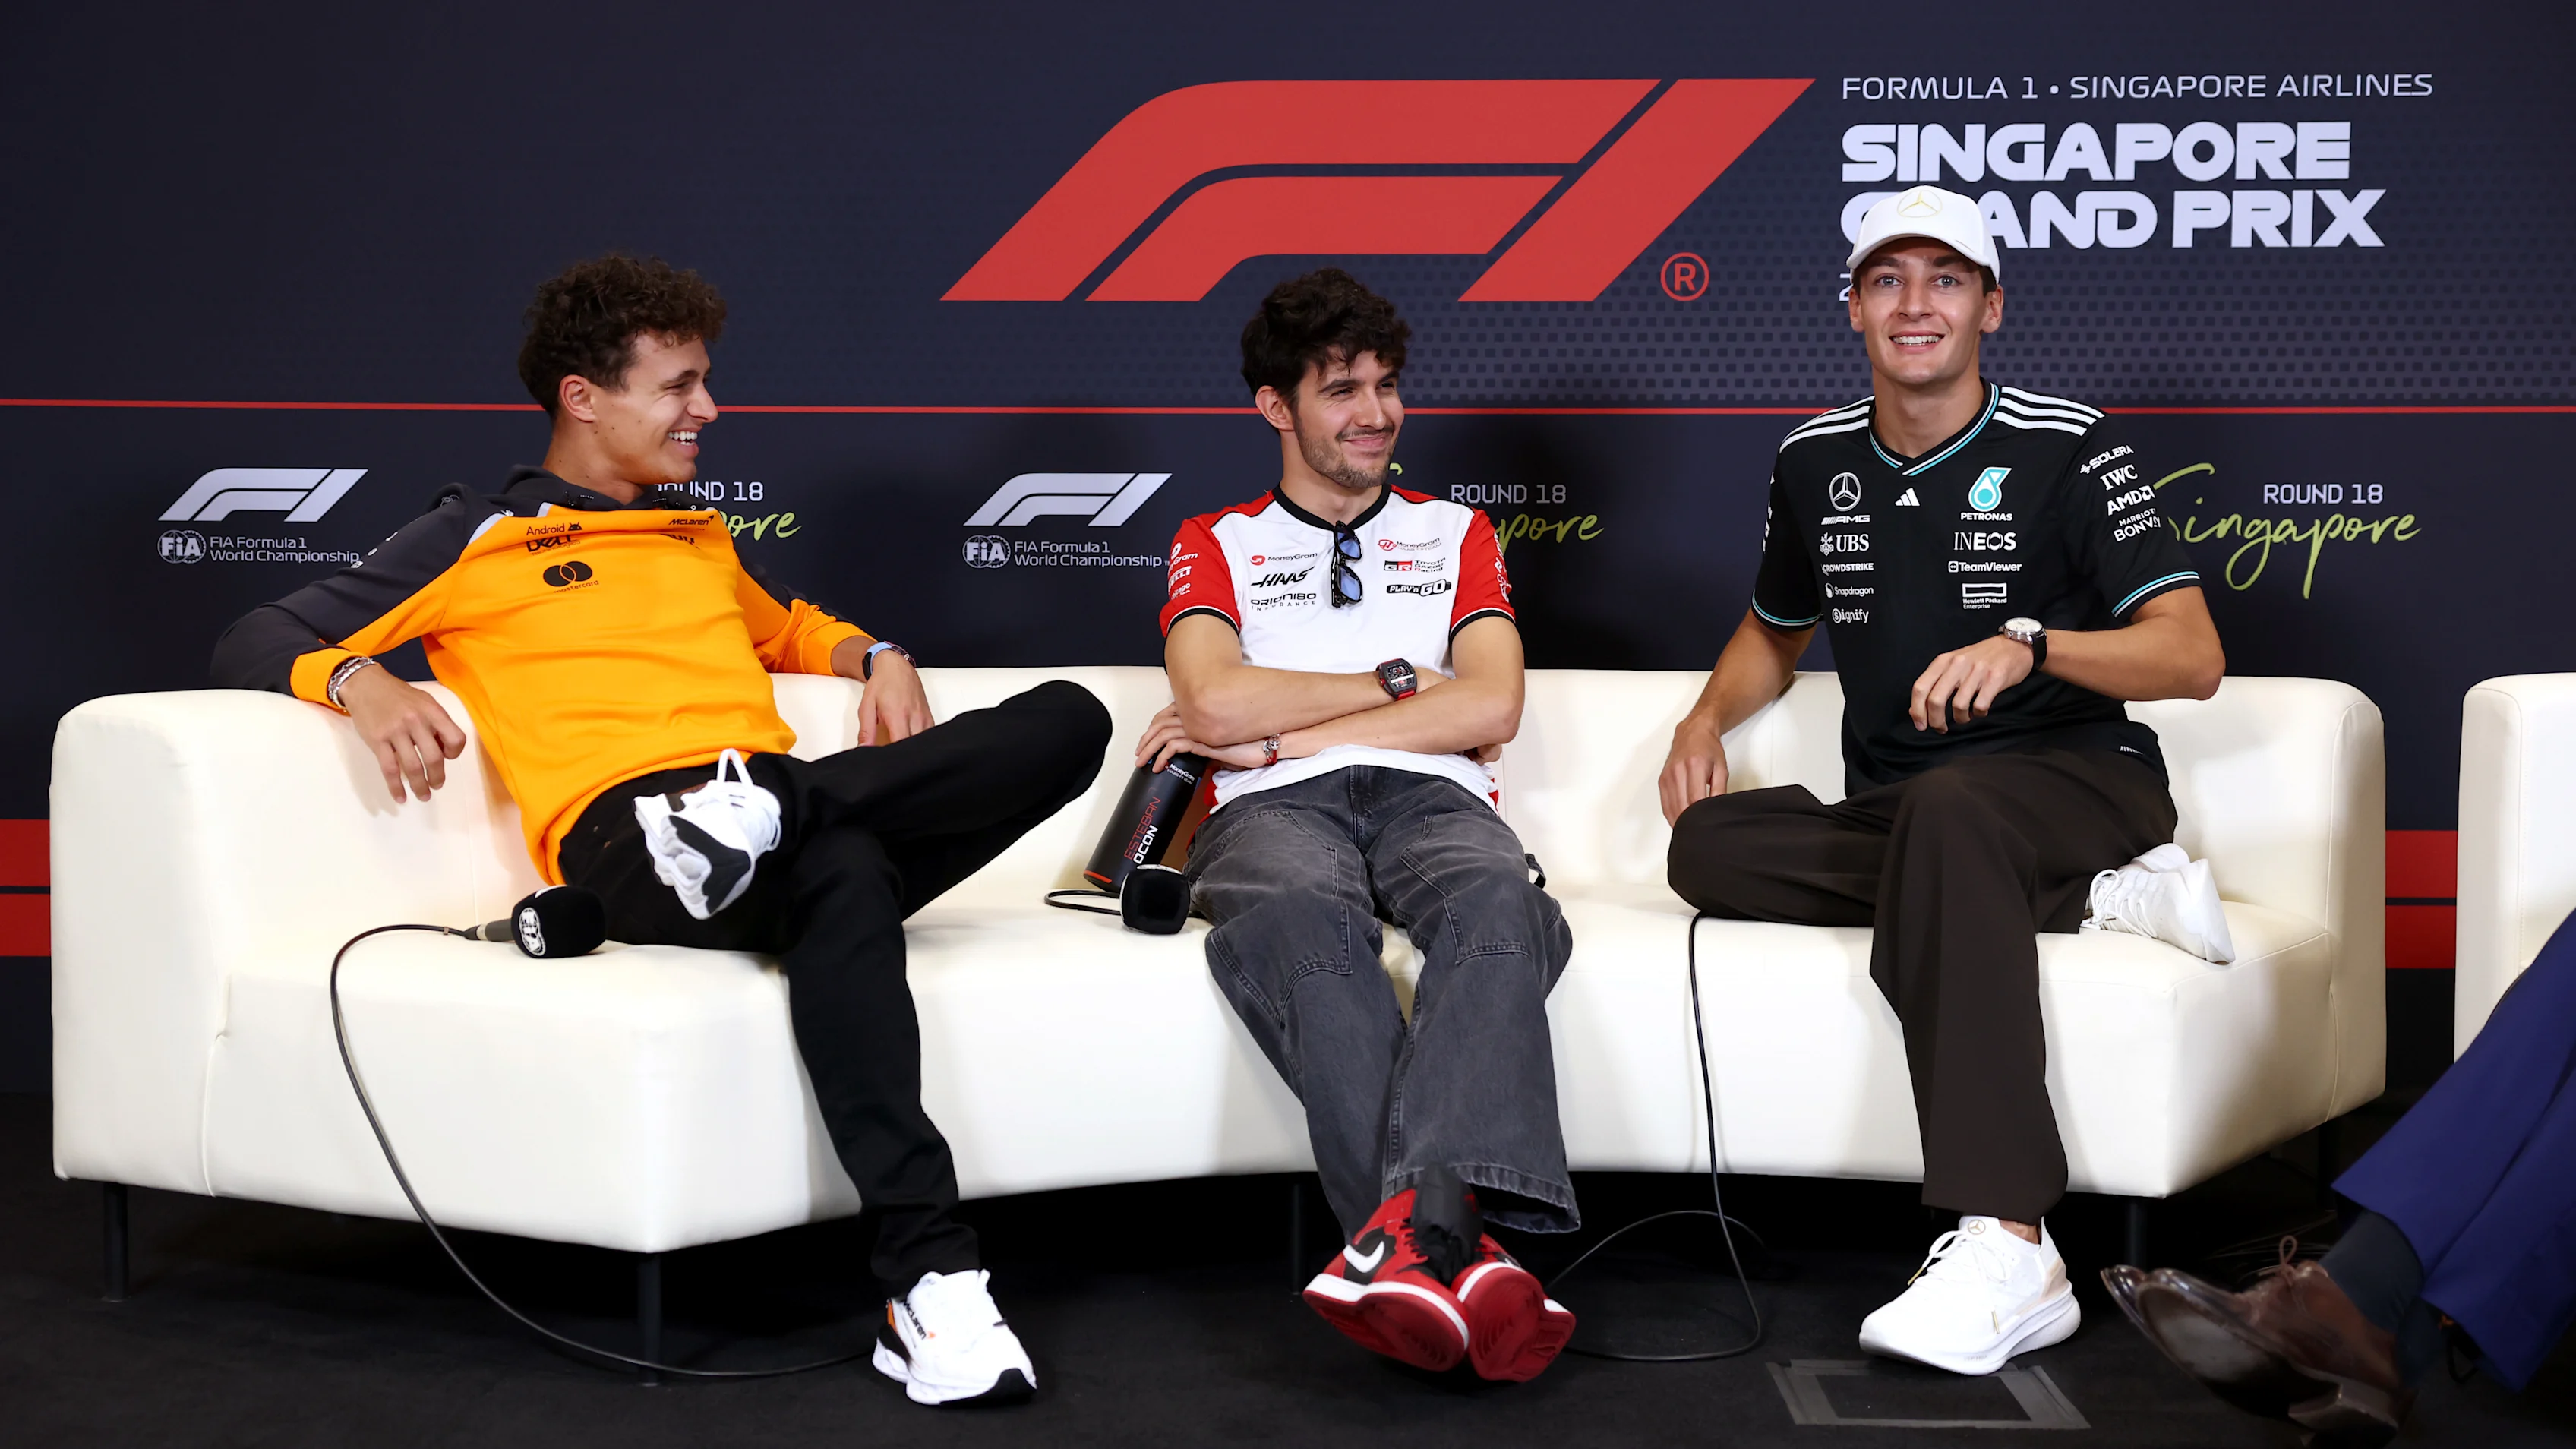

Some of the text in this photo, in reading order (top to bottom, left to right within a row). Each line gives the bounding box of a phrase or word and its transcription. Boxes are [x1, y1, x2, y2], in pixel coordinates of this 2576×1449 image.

[1842, 74, 2433, 99] FORMULA 1 SINGAPORE AIRLINES
[1842, 121, 2351, 182] SINGAPORE
[1840, 188, 2386, 249] GAND PRIX
[2089, 445, 2134, 469] SOLERA
[2100, 464, 2138, 491] IWC
[734, 481, 764, 501] 18
[1451, 484, 1567, 504] ROUND 18
[2264, 484, 2383, 504] ROUND 18
[2107, 490, 2142, 516] AMD
[1836, 514, 1870, 523] AMG
[1960, 513, 2012, 521] PETRONAS
[526, 523, 565, 535] Android
[210, 536, 307, 548] FIA Formula 1
[1014, 541, 1110, 553] FIA Formula 1
[1836, 534, 1870, 552] UBS
[1953, 532, 2017, 551] INEOS
[210, 550, 360, 564] World Championship
[1014, 554, 1057, 567] World
[1059, 554, 1163, 568] Championship
[1267, 553, 1318, 561] MoneyGram
[1822, 563, 1874, 573] CROWDSTRIKE
[1959, 561, 2022, 572] TeamViewer
[1251, 565, 1315, 588] HAAS
[1419, 579, 1447, 597] GO
[1834, 586, 1874, 597] Snapdragon
[1123, 796, 1161, 860] ESTEBAN
[1133, 825, 1158, 864] OCON
